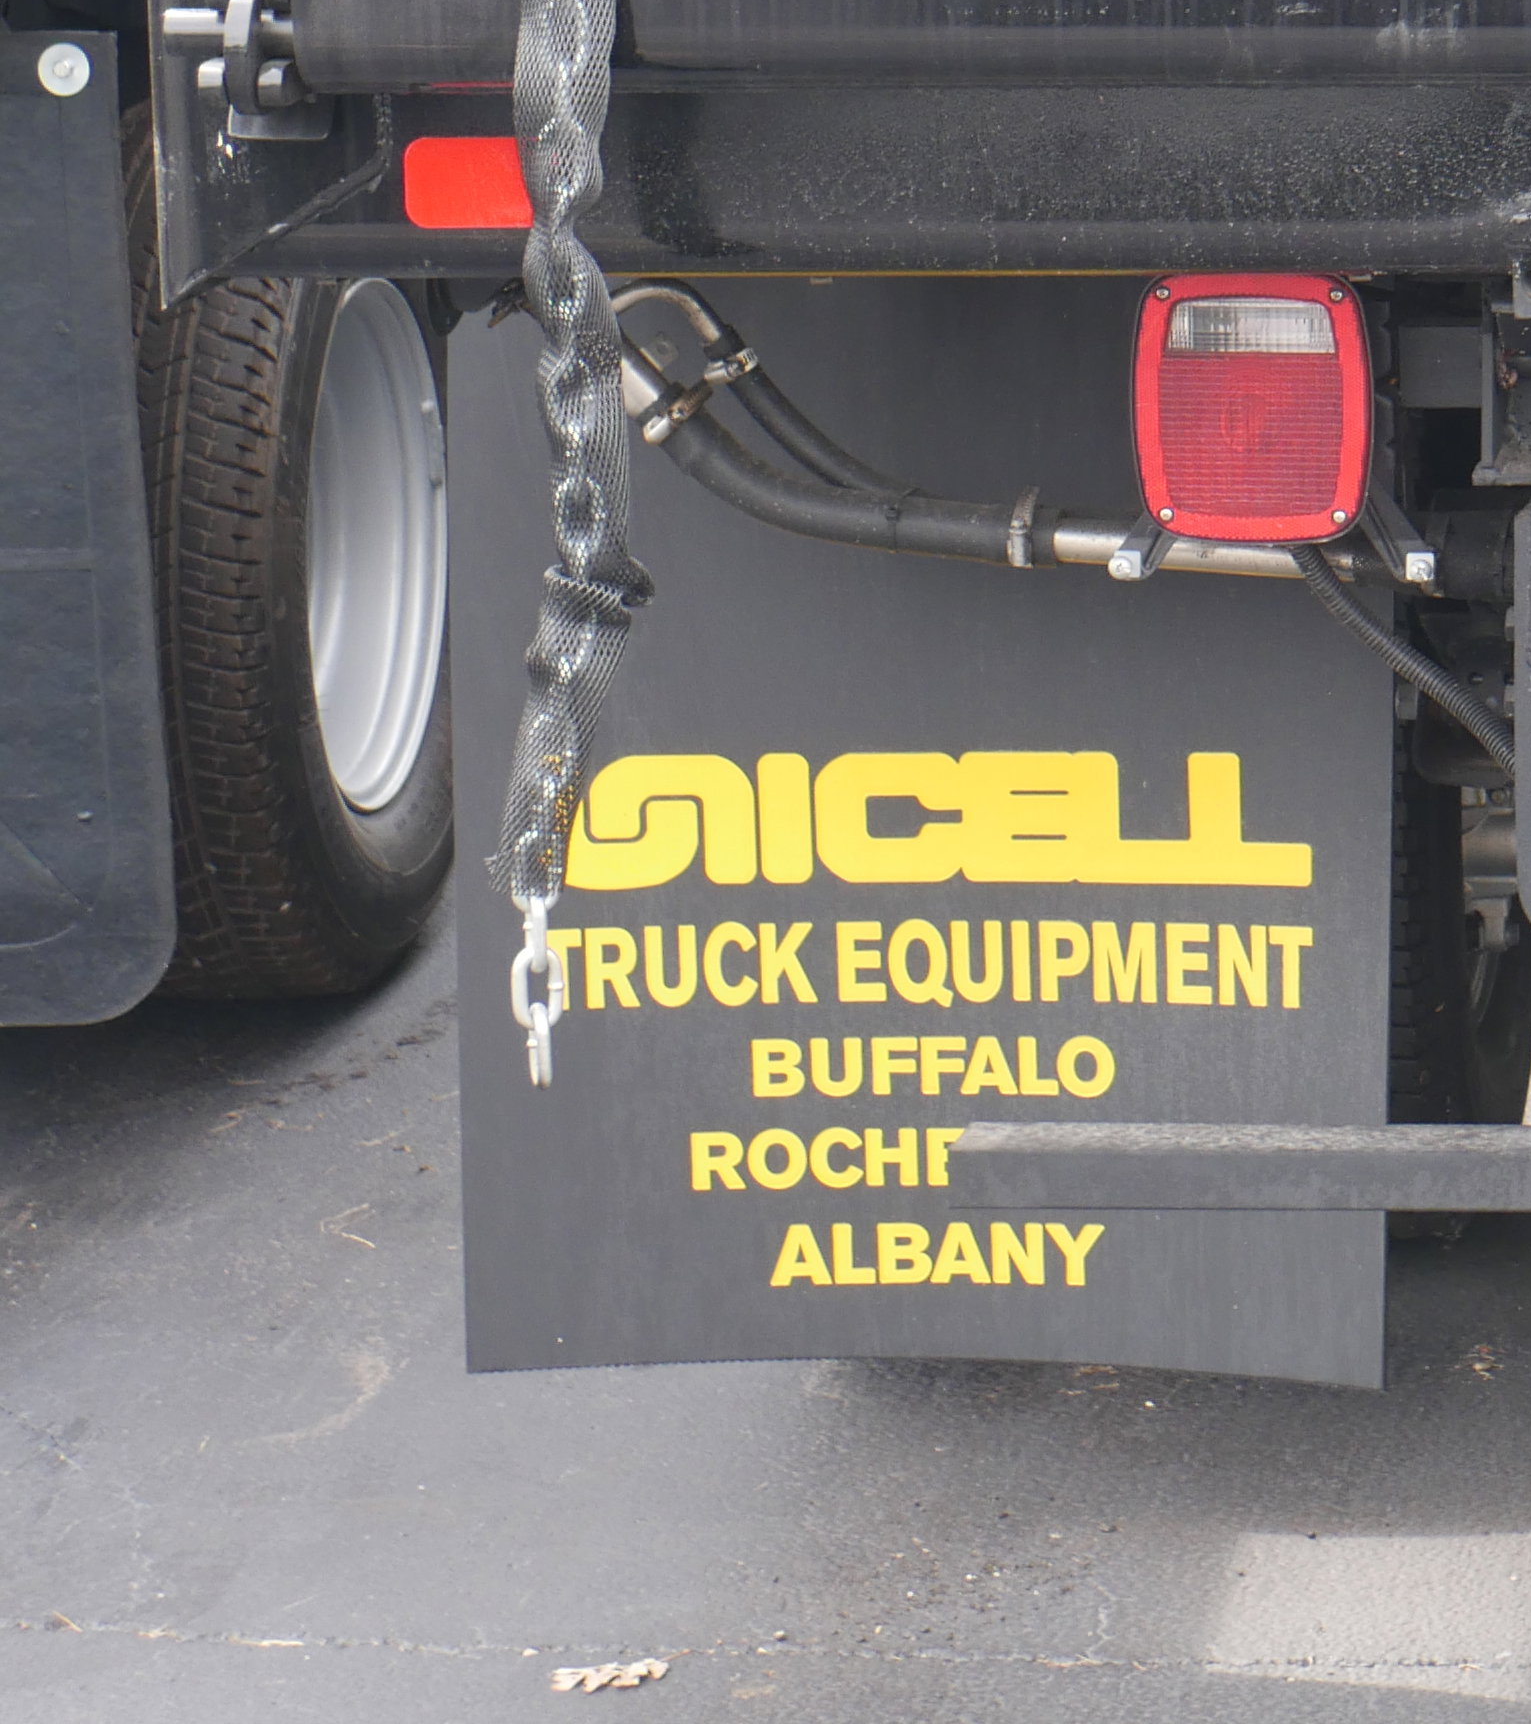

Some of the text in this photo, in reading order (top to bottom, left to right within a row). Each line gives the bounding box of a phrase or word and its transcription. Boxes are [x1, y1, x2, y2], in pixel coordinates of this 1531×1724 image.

[546, 920, 1313, 1011] TRUCK EQUIPMENT
[751, 1037, 1116, 1098] BUFFALO
[770, 1223, 1104, 1287] ALBANY
